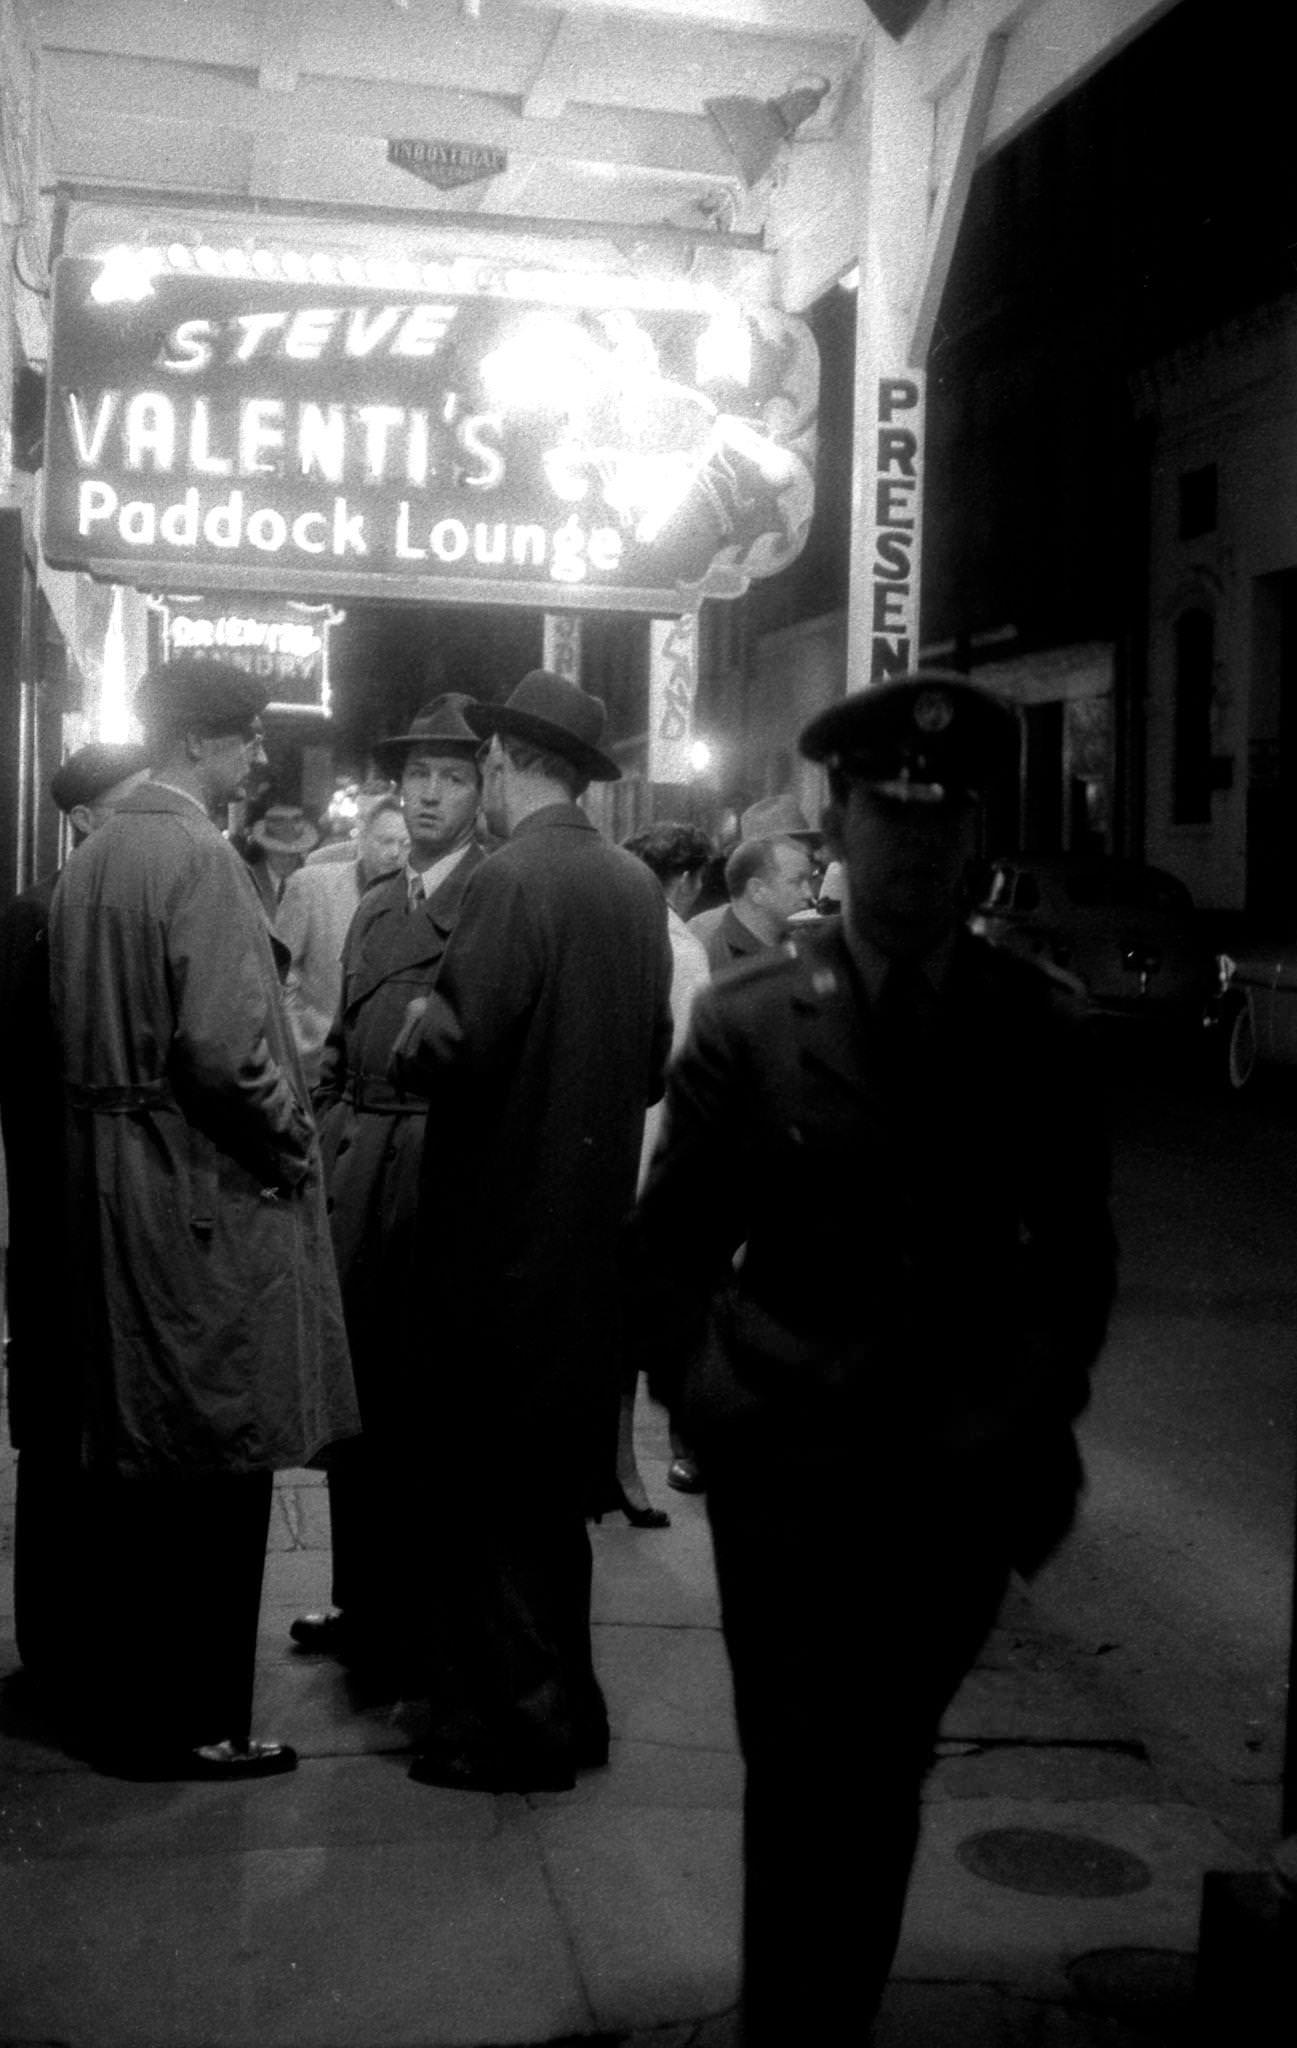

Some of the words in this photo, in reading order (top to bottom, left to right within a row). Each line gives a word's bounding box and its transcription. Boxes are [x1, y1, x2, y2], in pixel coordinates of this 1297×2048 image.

[157, 303, 458, 374] STEVE
[66, 390, 505, 490] VALENTI'S
[77, 479, 369, 557] Paddock
[395, 501, 624, 583] Lounge
